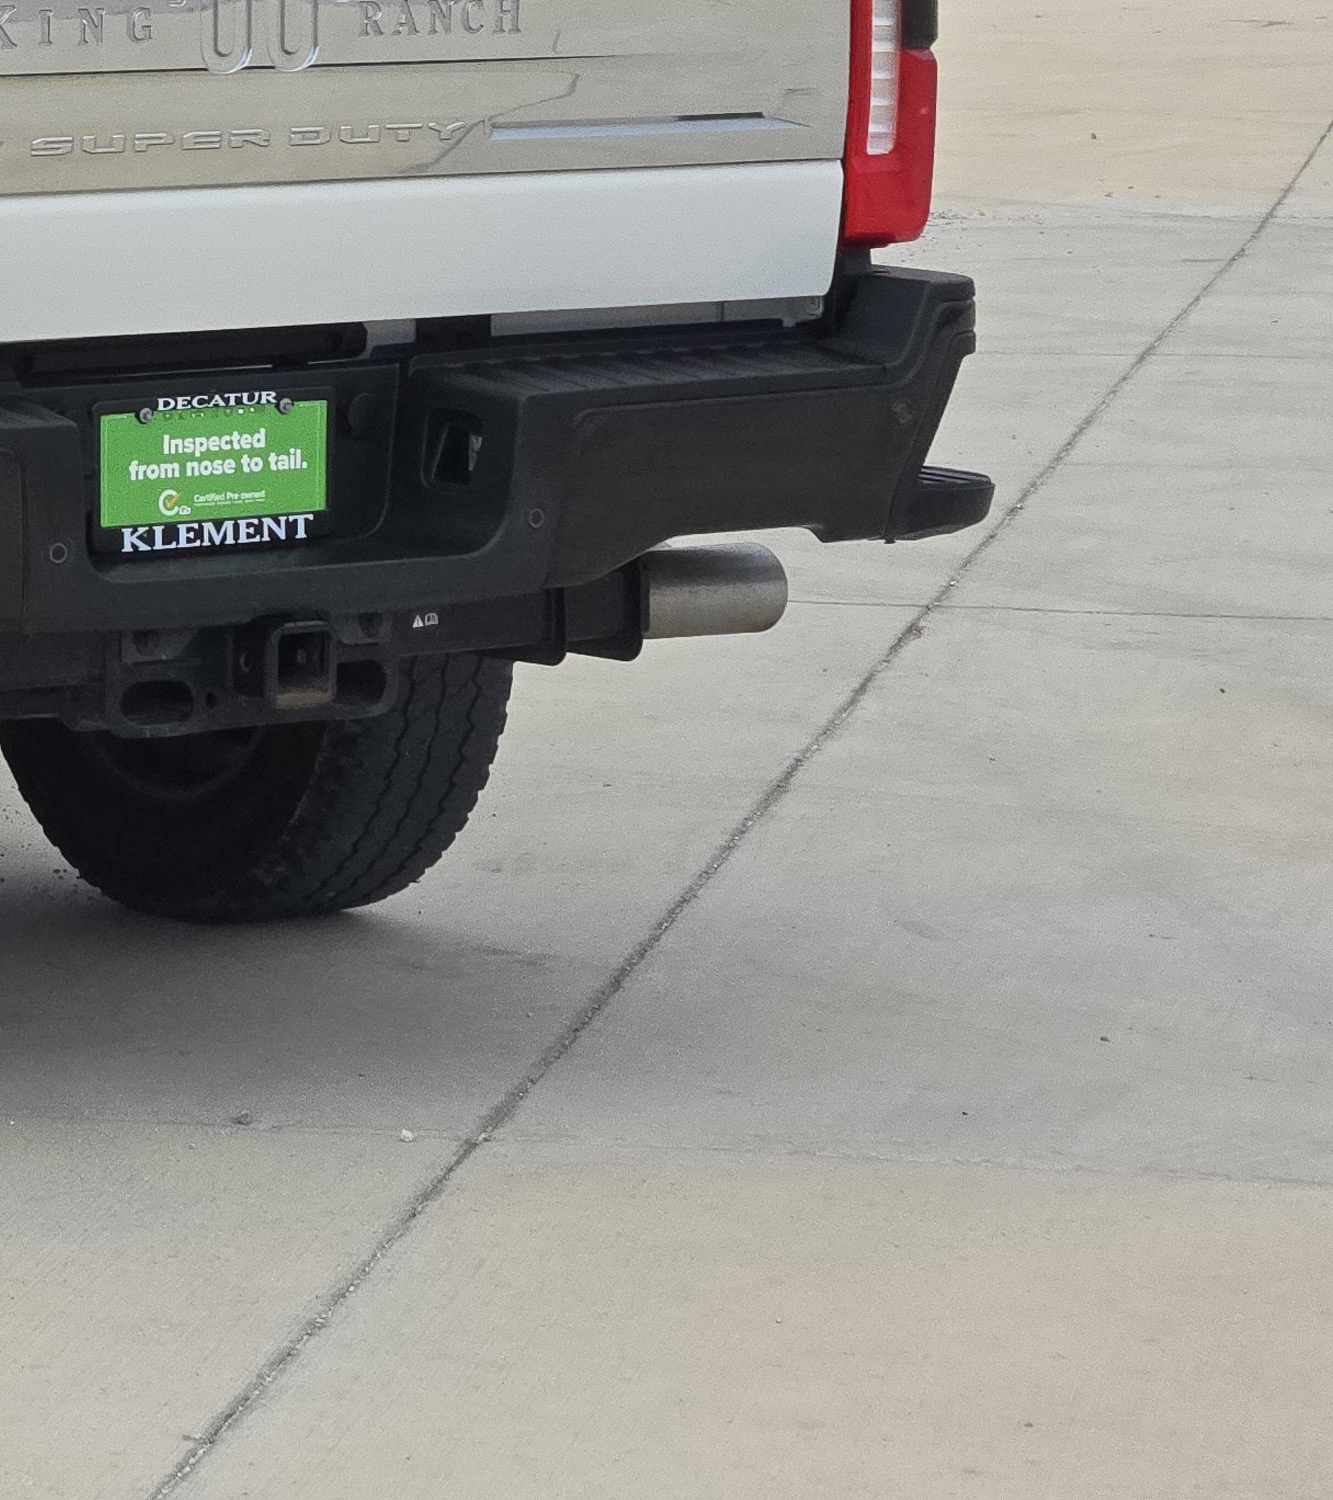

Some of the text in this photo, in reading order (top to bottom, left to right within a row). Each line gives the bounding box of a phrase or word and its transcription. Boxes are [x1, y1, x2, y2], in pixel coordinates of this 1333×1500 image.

[30, 120, 468, 157] SUPER DUTY
[157, 390, 278, 412] DECATUR
[162, 428, 266, 458] Inspected
[128, 447, 309, 481] from nose to tail.
[193, 491, 226, 503] Certified
[120, 513, 315, 553] KLEMENT
